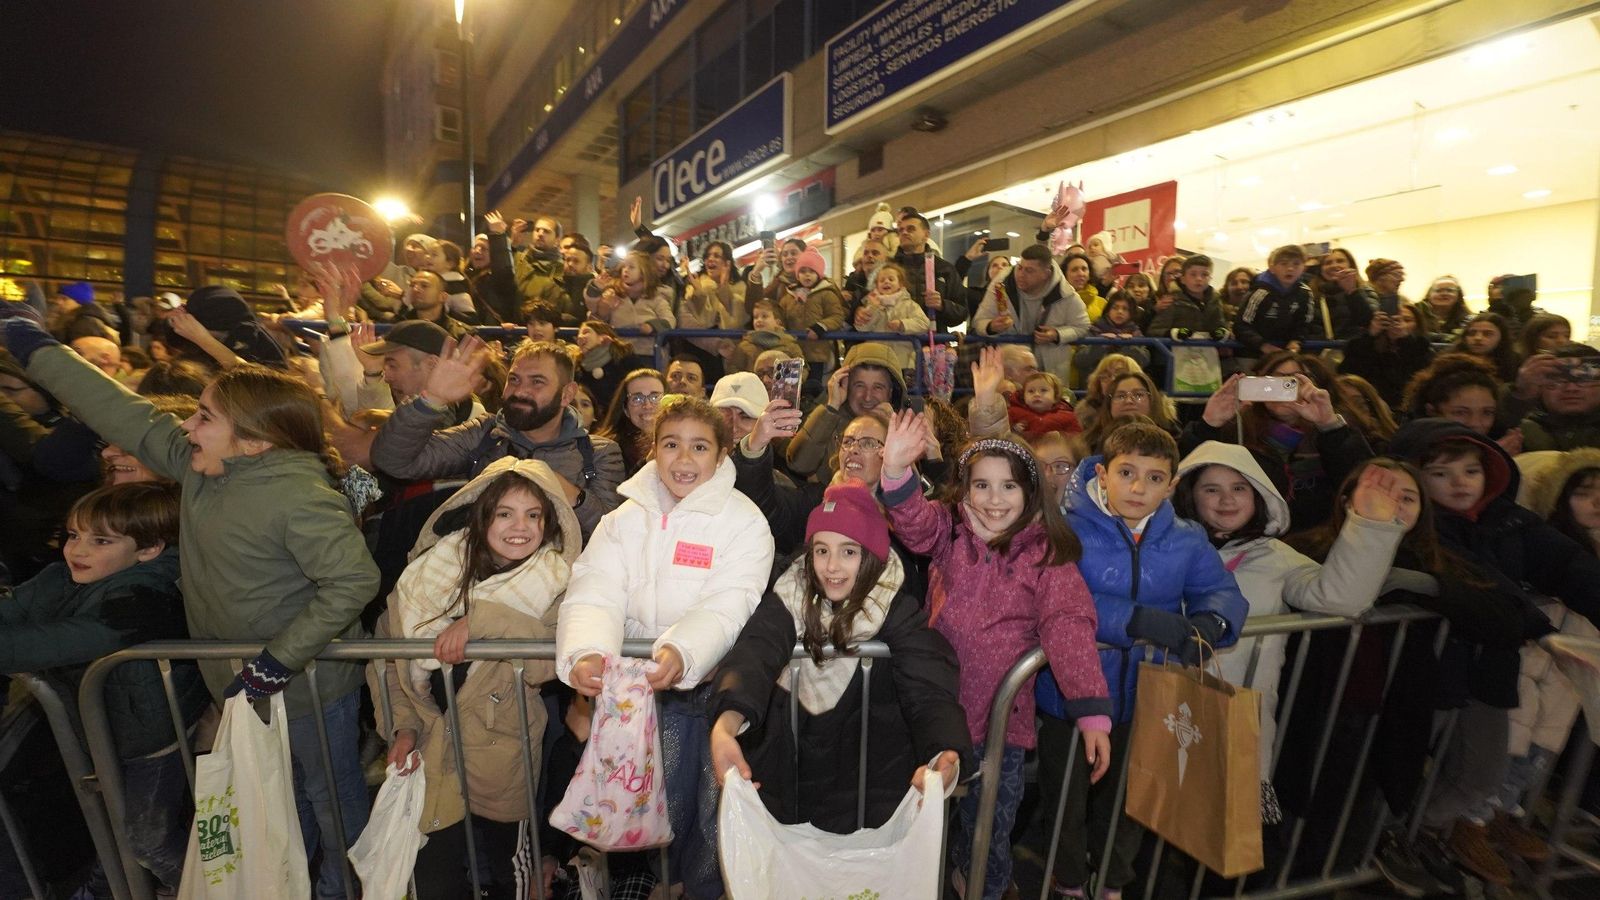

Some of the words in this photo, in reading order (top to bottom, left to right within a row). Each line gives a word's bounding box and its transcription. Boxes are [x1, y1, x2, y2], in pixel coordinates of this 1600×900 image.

[832, 54, 880, 90] SERVICIOS
[880, 22, 933, 62] SOCIALES
[833, 43, 873, 75] LIMPIEZA
[886, 33, 942, 75] SERVICIOS
[832, 83, 885, 119] SEGURIDAD
[655, 139, 726, 214] Clece
